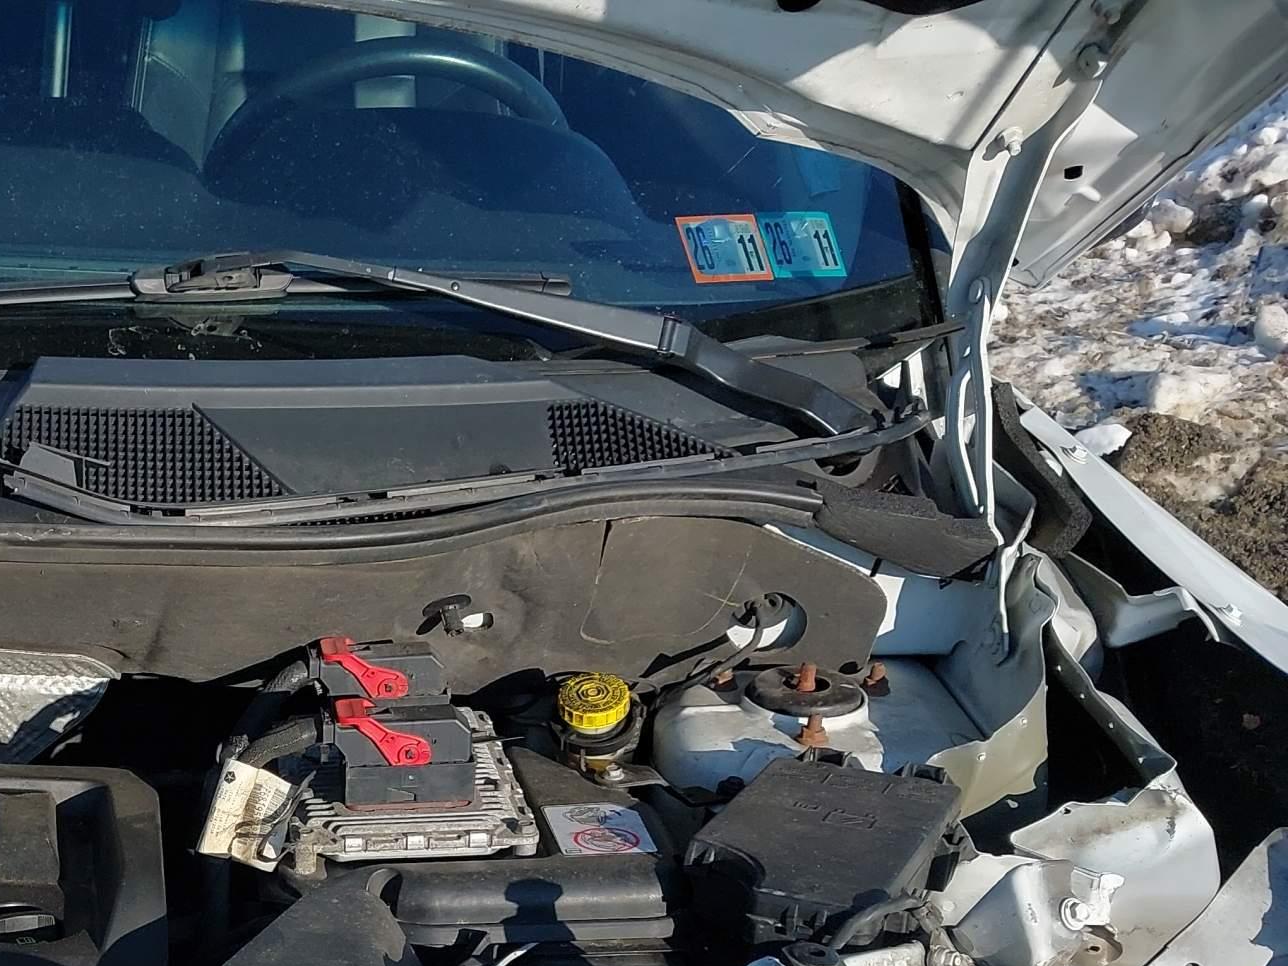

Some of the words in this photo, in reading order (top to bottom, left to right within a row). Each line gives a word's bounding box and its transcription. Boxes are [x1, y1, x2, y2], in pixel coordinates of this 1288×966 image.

[685, 227, 714, 270] 26
[737, 234, 765, 271] 11
[764, 222, 793, 265] 26
[813, 229, 839, 266] 11
